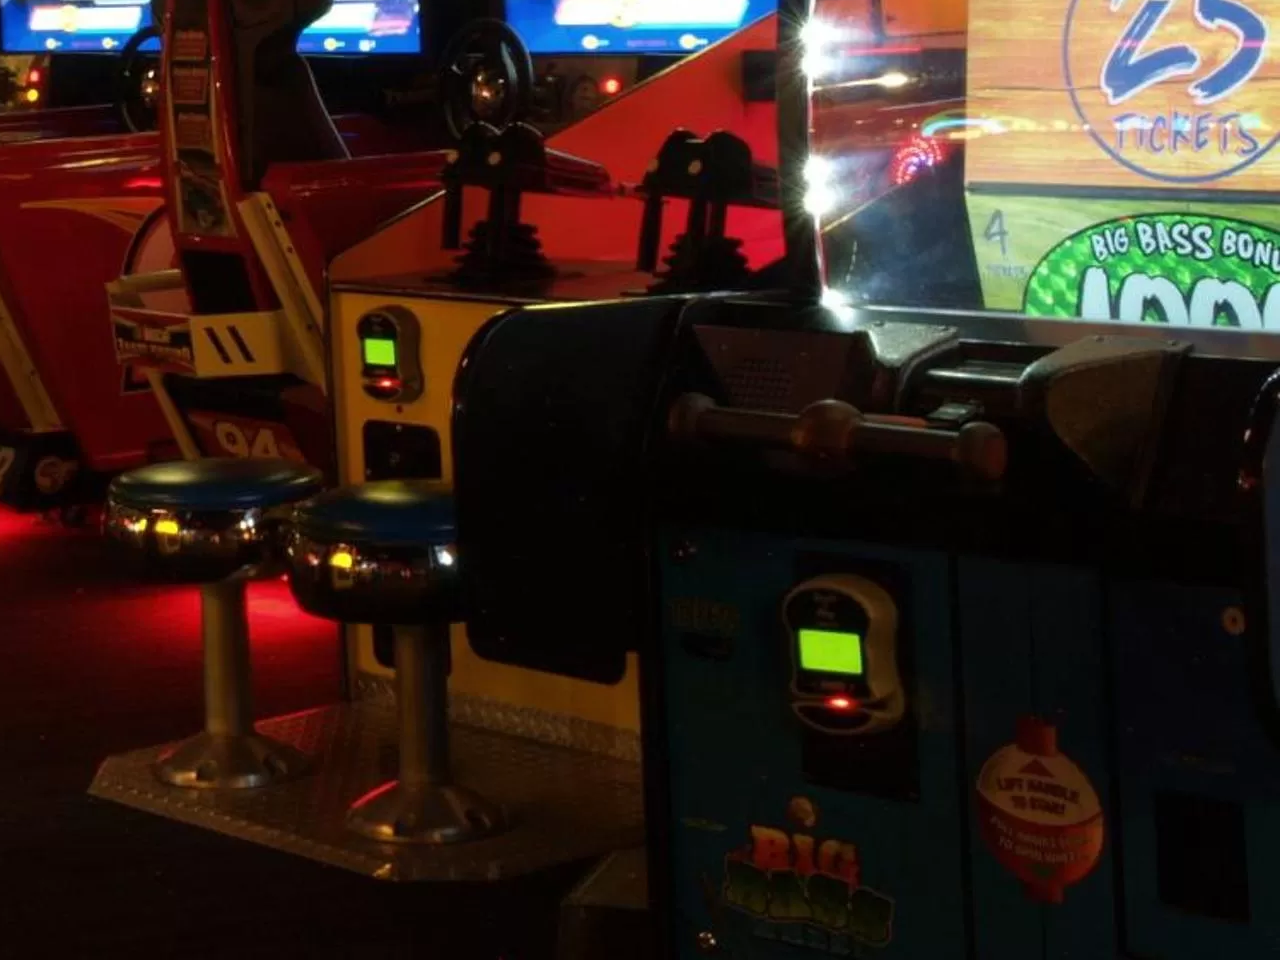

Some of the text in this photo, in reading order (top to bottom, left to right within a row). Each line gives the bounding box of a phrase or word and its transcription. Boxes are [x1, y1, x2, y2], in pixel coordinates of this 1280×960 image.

[1112, 110, 1263, 156] TICKETS
[983, 208, 1008, 257] 4
[1090, 220, 1280, 274] BIG BASS BONU
[748, 823, 862, 890] BIG
